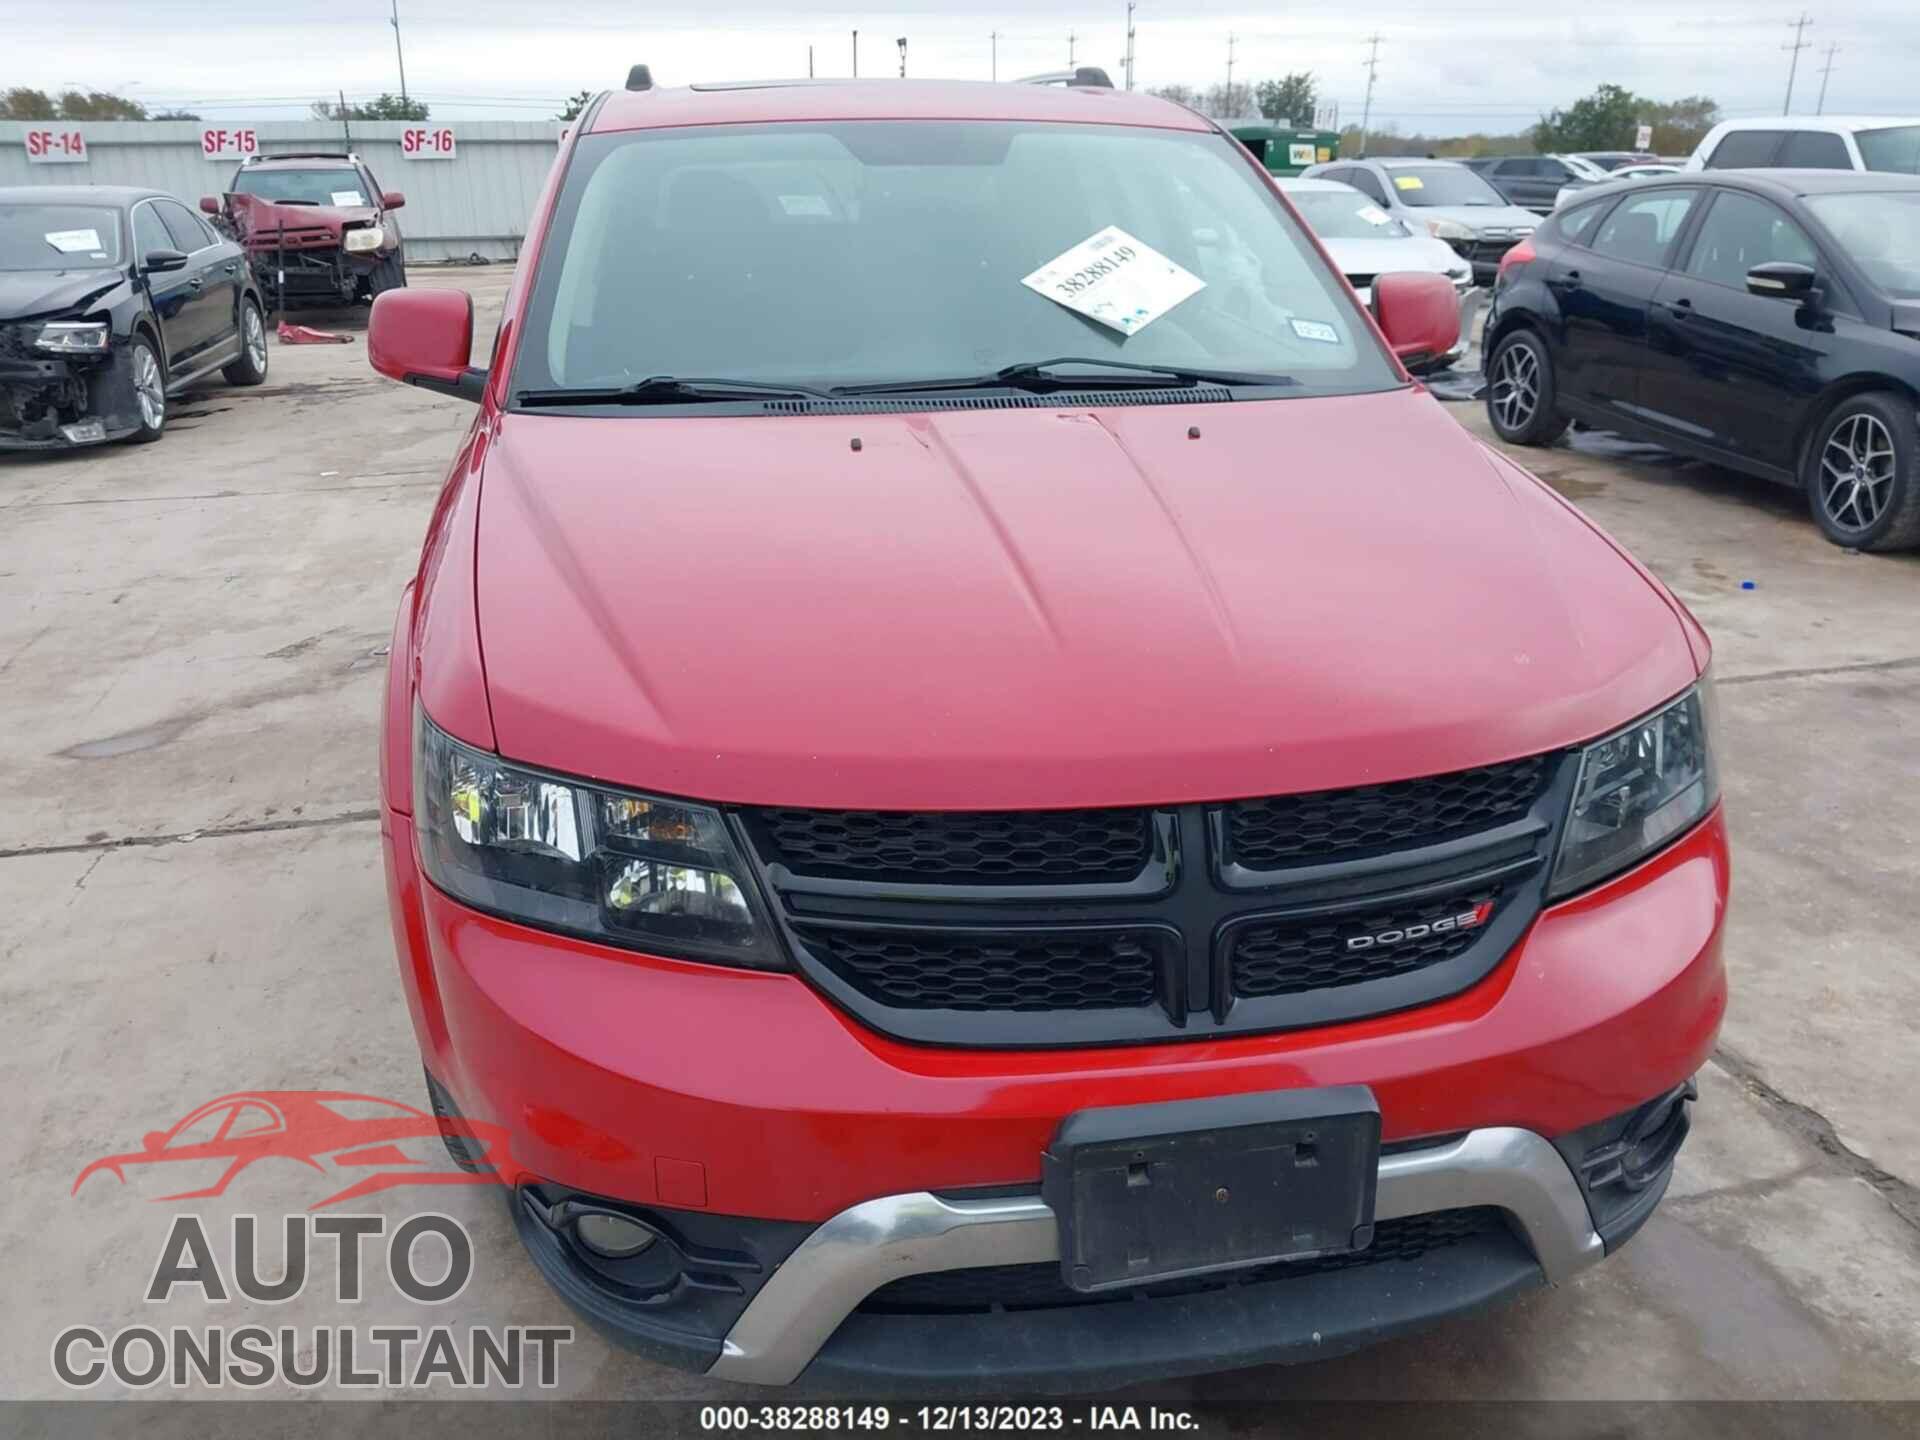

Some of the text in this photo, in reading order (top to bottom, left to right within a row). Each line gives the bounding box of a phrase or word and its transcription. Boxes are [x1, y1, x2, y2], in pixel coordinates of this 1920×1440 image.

[28, 132, 81, 153] SF-14
[204, 130, 256, 153] SF-15
[404, 130, 453, 152] SF-16
[1056, 245, 1137, 298] 38288149
[1347, 910, 1478, 949] DODGE
